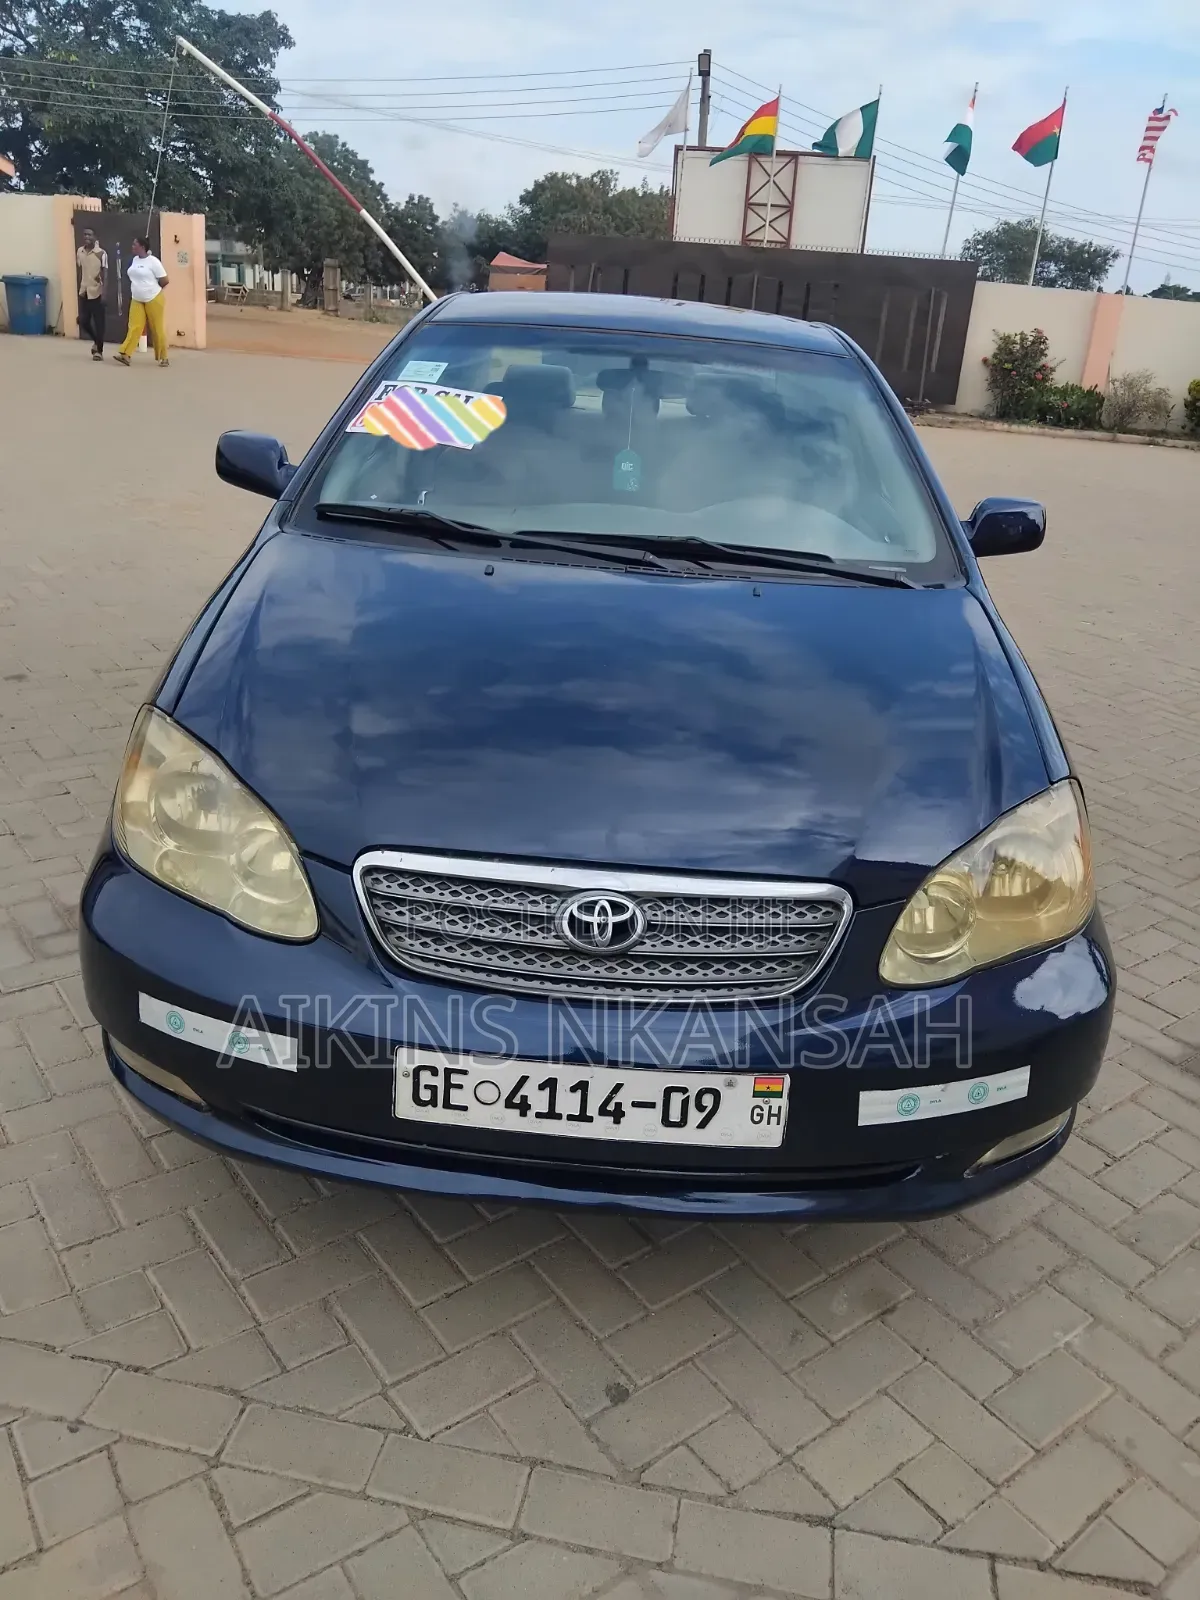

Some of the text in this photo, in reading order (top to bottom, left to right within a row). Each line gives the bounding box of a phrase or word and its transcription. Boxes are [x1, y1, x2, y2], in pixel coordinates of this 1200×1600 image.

[411, 1064, 722, 1130] GE 4114-09
[750, 1104, 782, 1126] GH
